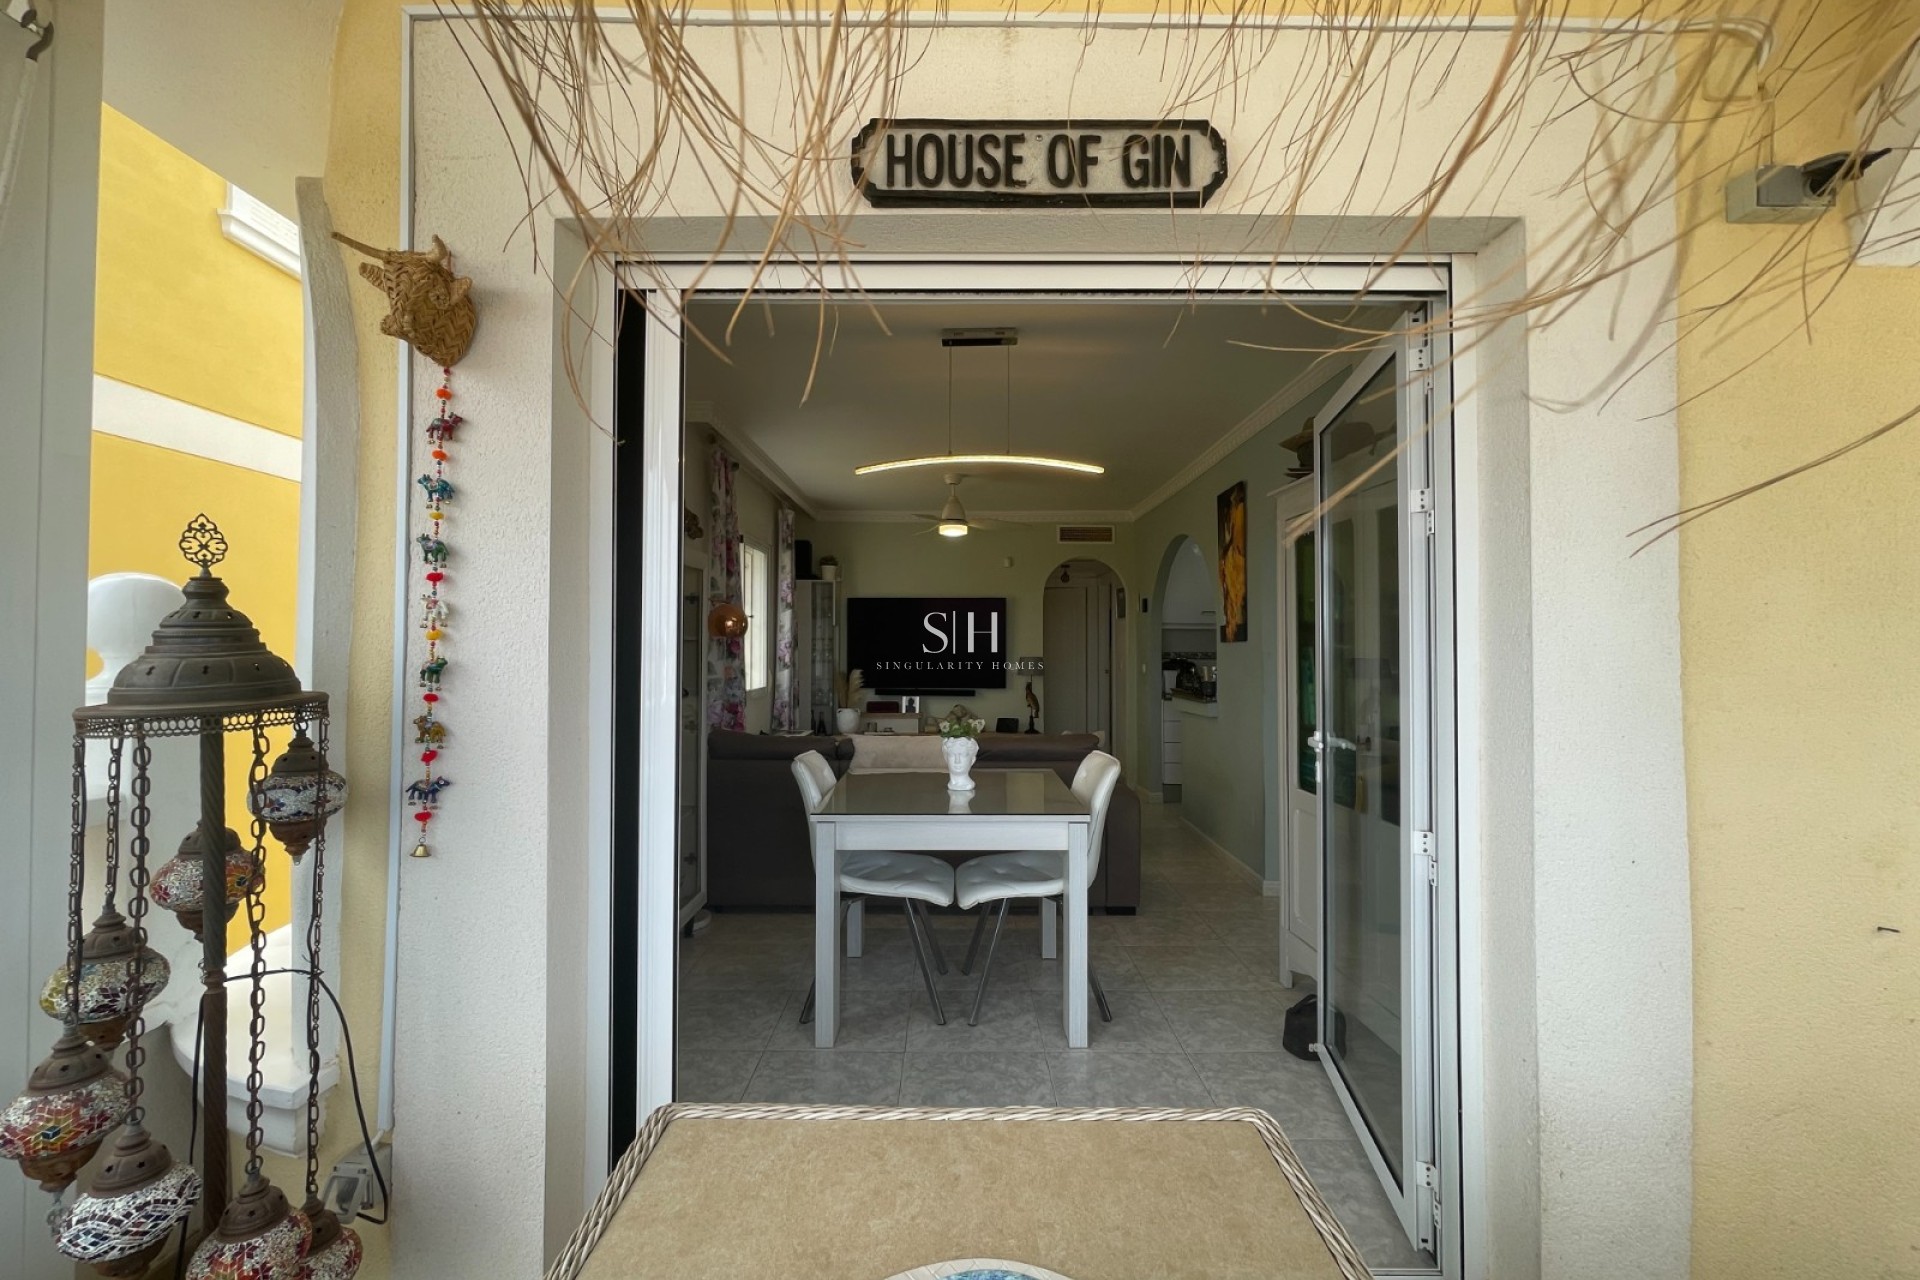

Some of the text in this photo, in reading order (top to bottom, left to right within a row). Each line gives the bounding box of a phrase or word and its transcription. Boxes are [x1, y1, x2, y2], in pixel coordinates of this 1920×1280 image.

[886, 133, 1191, 188] HOUSE OF GIN
